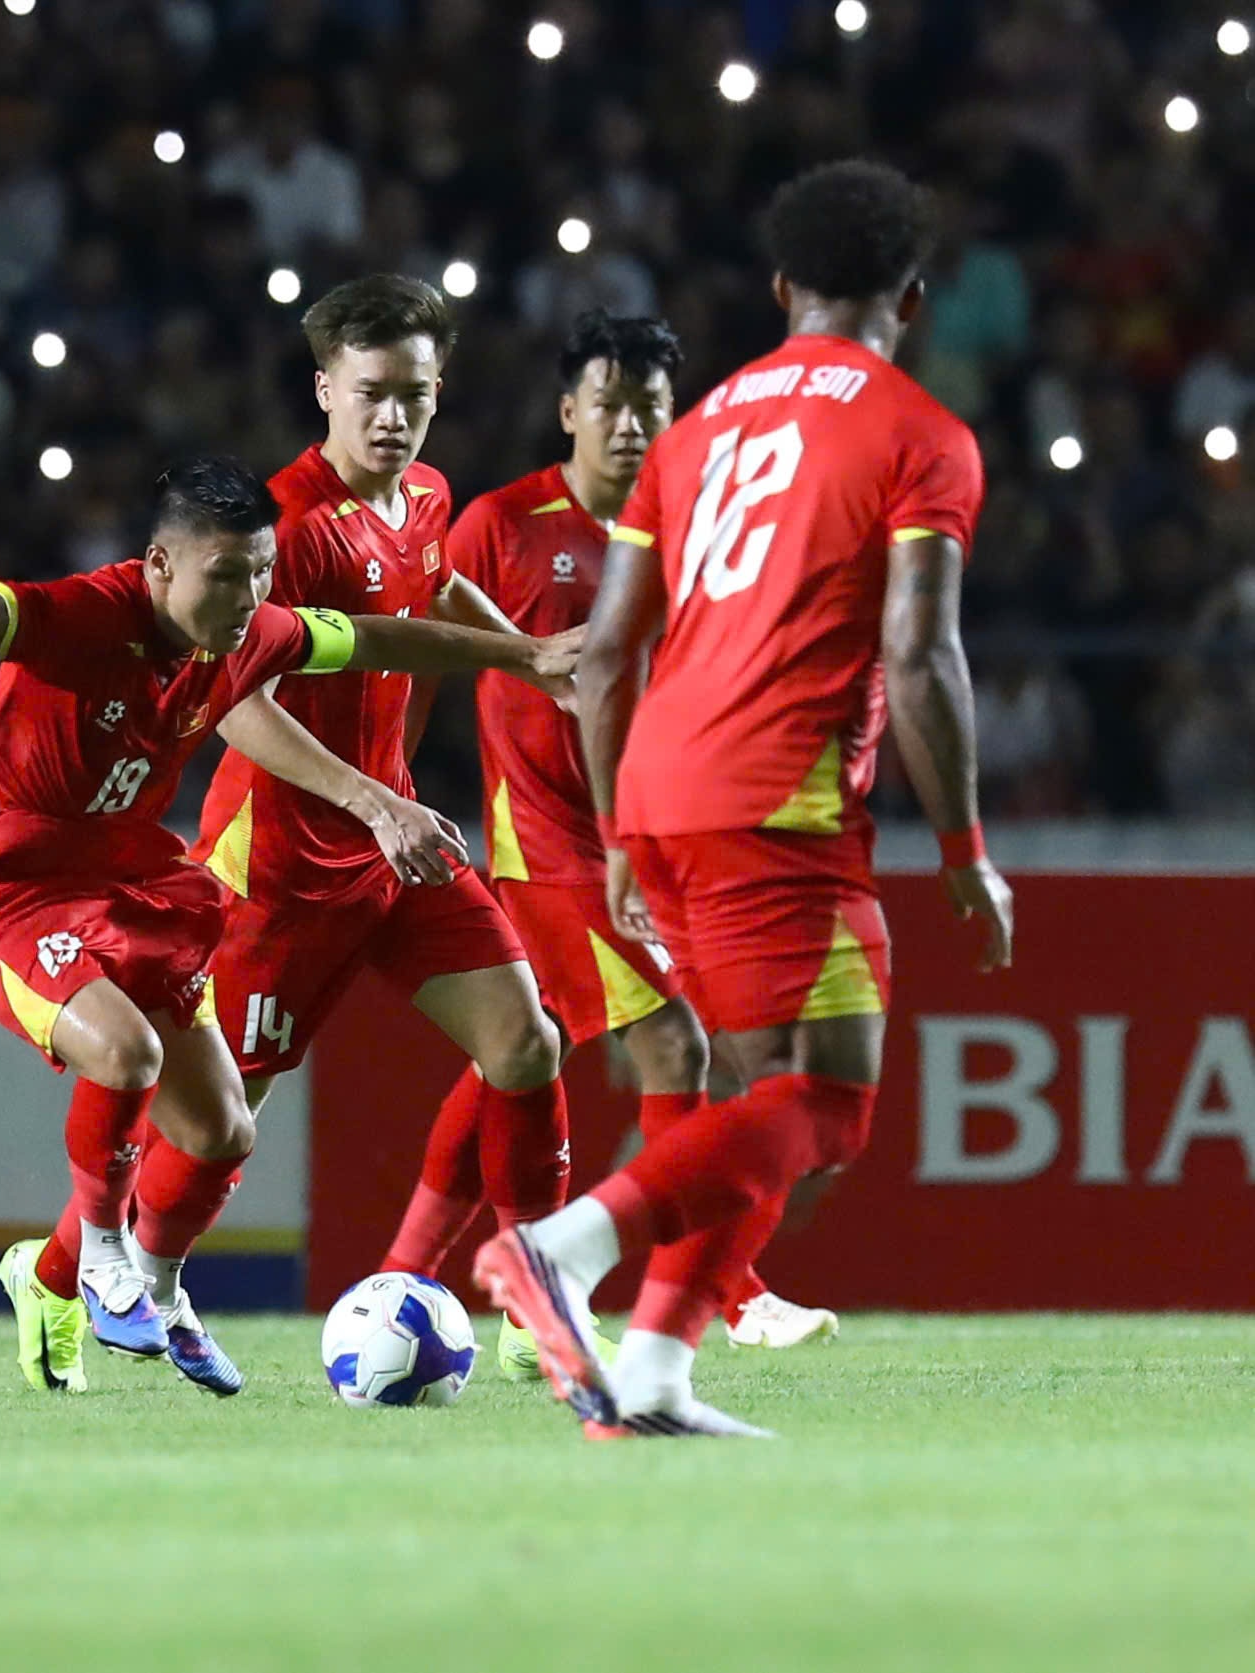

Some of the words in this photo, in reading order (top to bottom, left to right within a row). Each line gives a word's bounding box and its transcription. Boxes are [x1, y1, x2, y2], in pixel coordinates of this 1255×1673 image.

[677, 420, 804, 608] 12
[84, 757, 151, 814] 19
[242, 993, 295, 1055] 14
[913, 1013, 1255, 1185] BIA
